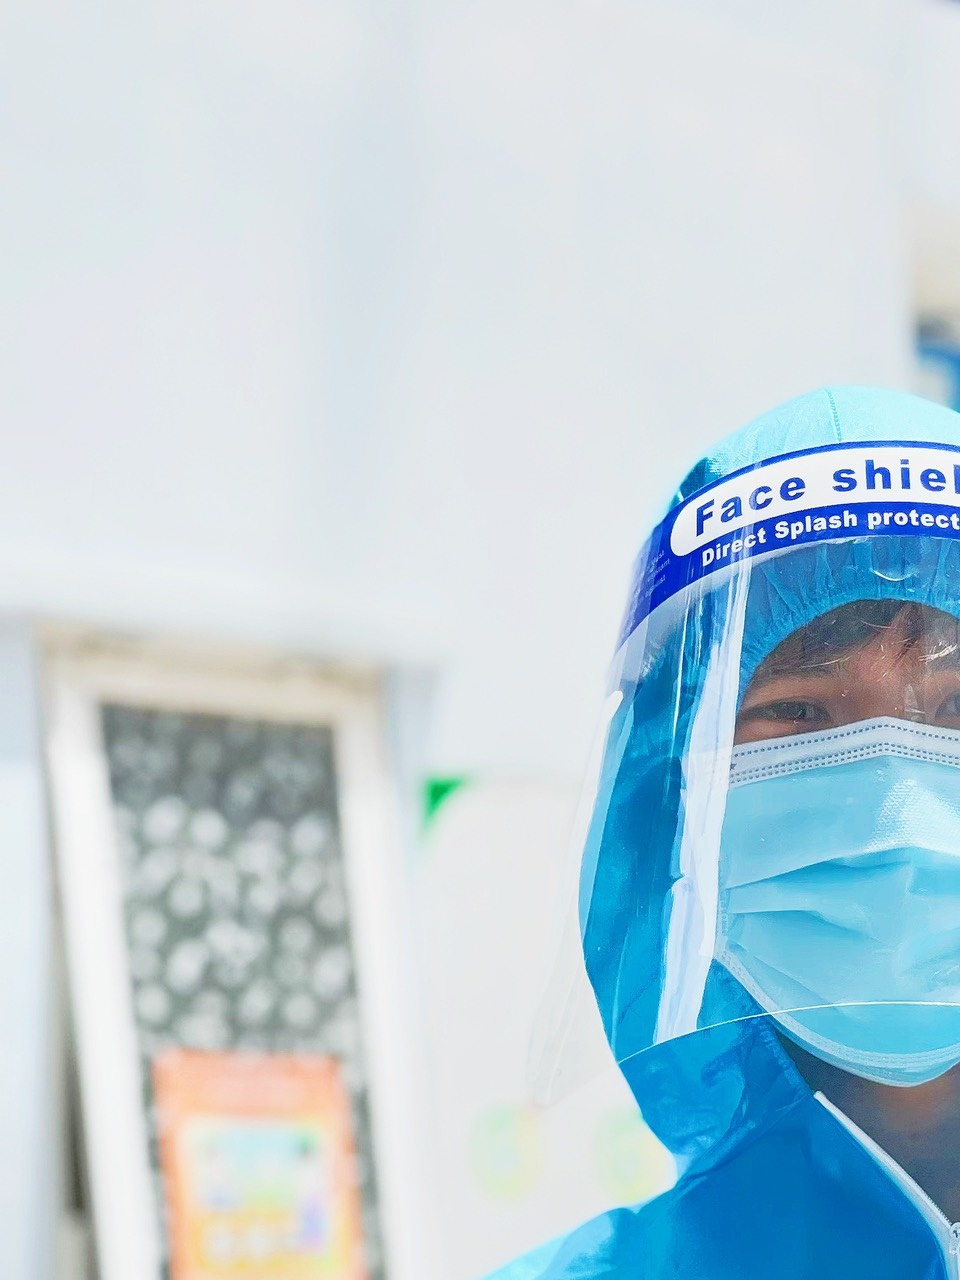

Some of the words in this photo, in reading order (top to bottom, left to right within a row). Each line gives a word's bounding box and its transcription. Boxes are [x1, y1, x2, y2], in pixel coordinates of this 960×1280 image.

[695, 476, 806, 538] Face
[702, 527, 767, 567] Direct
[774, 509, 858, 540] Splash
